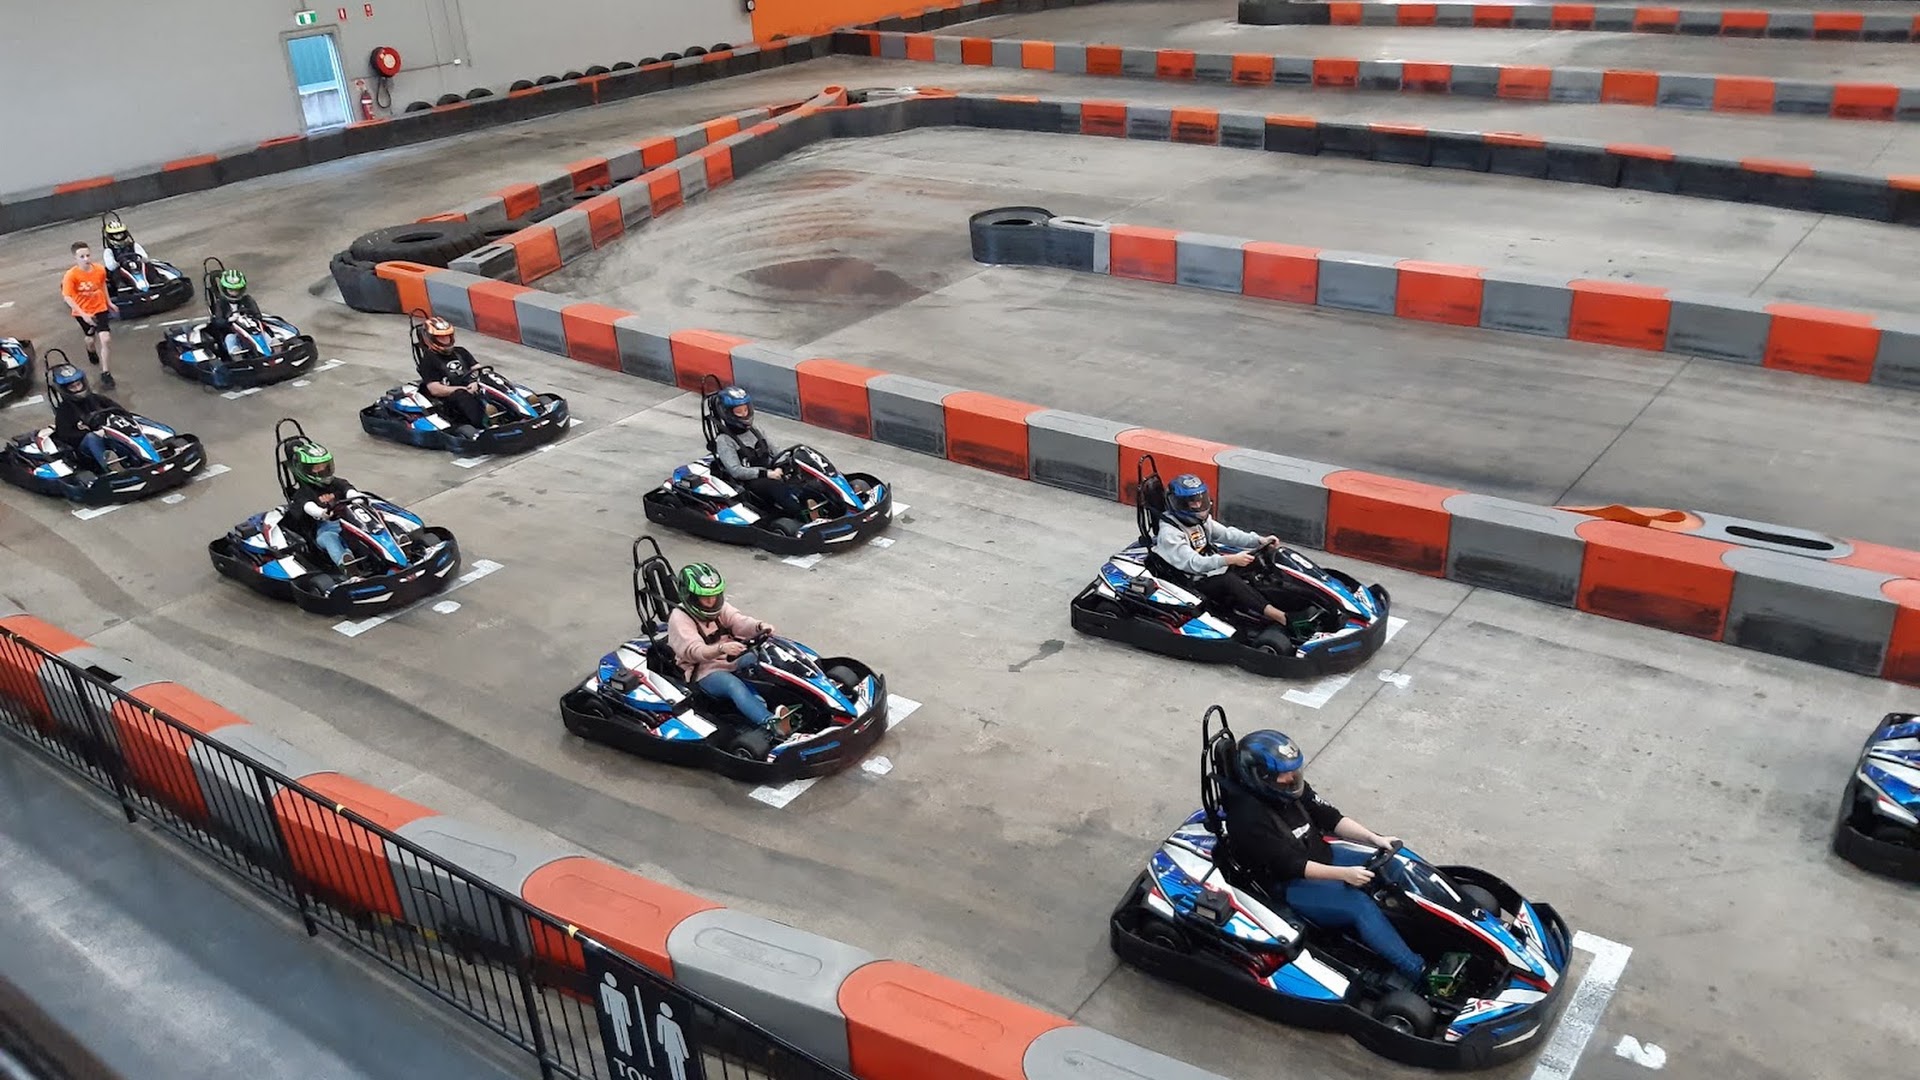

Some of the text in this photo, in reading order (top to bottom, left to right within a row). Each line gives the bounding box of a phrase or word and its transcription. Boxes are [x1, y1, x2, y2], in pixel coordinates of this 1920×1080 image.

[354, 508, 371, 522] 6
[1290, 553, 1313, 569] 8
[1429, 873, 1461, 902] 1
